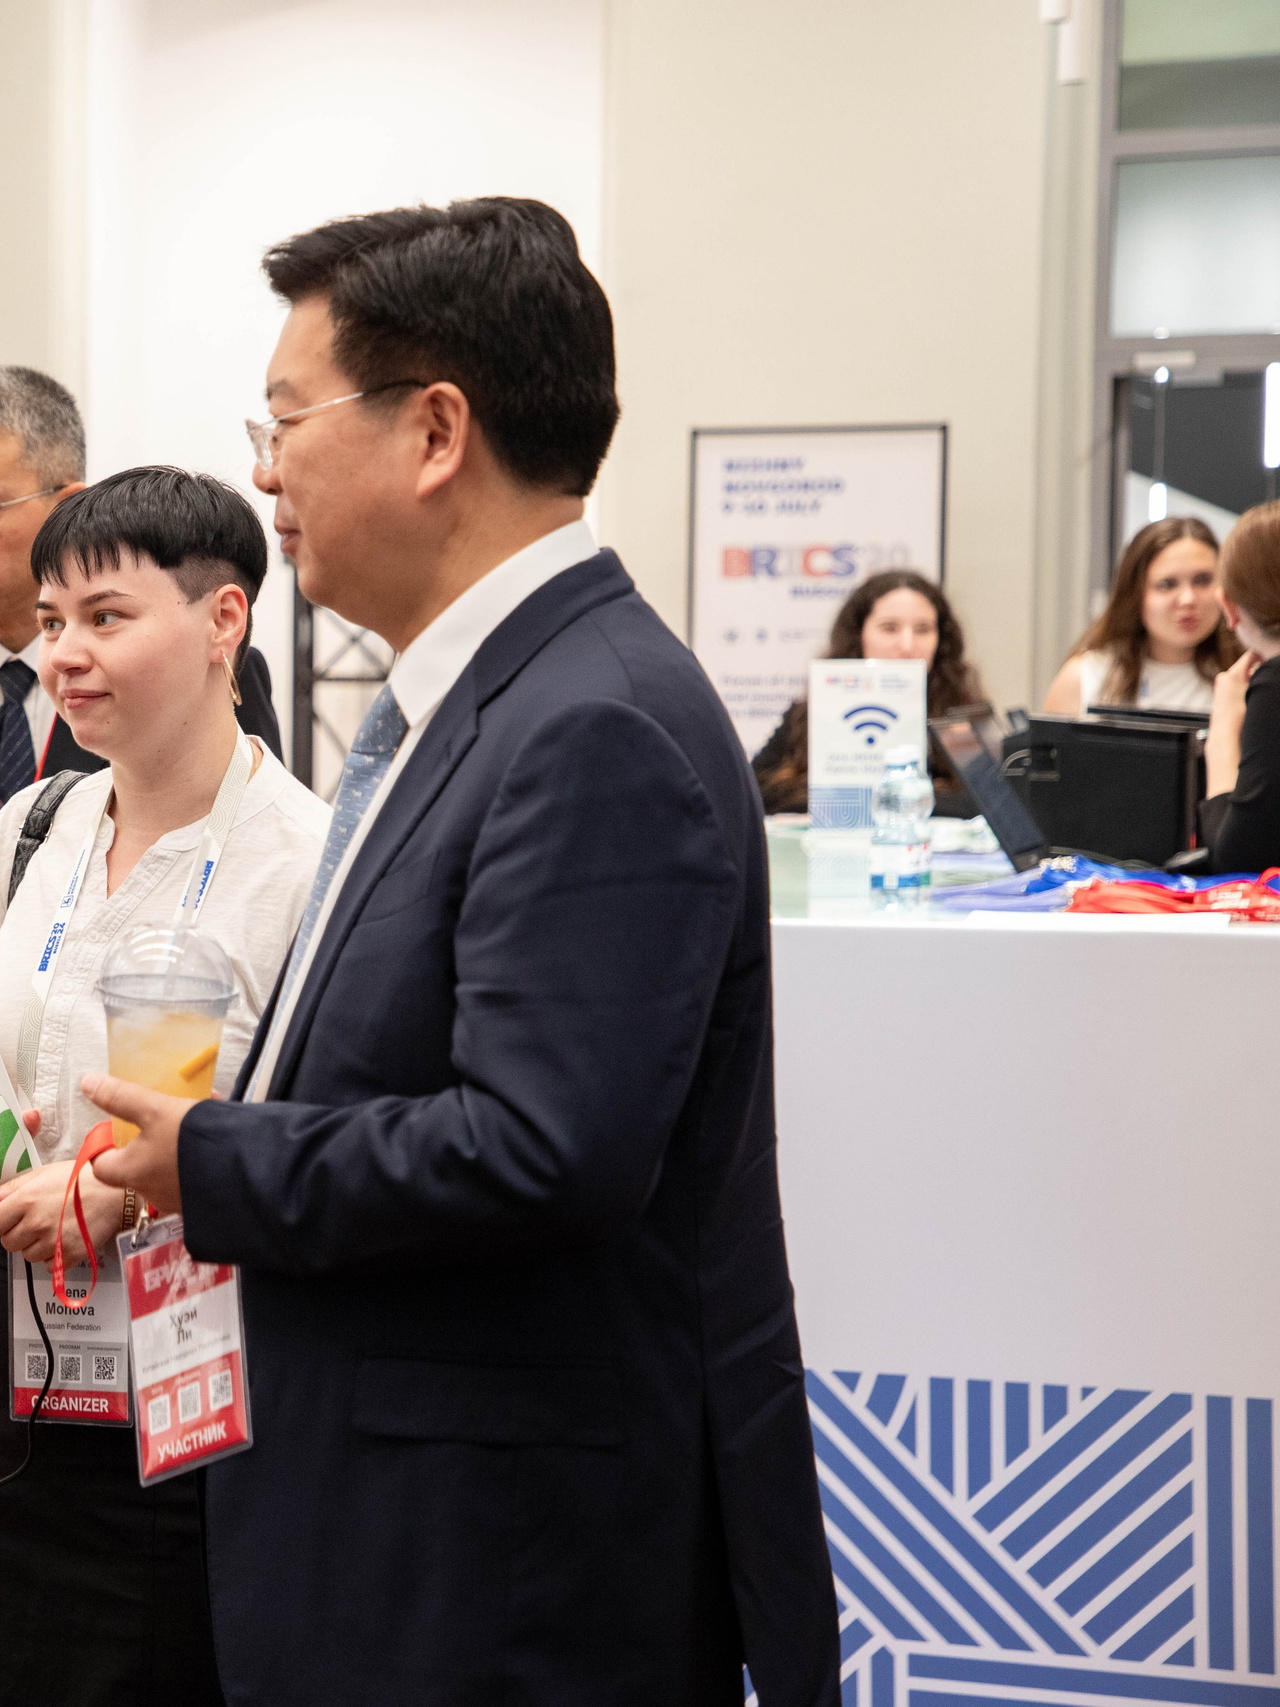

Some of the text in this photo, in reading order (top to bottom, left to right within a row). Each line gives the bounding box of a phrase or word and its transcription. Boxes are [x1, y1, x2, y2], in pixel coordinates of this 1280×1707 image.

[722, 545, 857, 577] BRICS
[37, 935, 57, 971] BRICS
[52, 1287, 87, 1298] ena
[42, 1322, 101, 1332] ussian Federation
[177, 1328, 193, 1345] Ли
[31, 1394, 109, 1413] ORGANIZER
[157, 1420, 227, 1464] УЧАСТНИК
